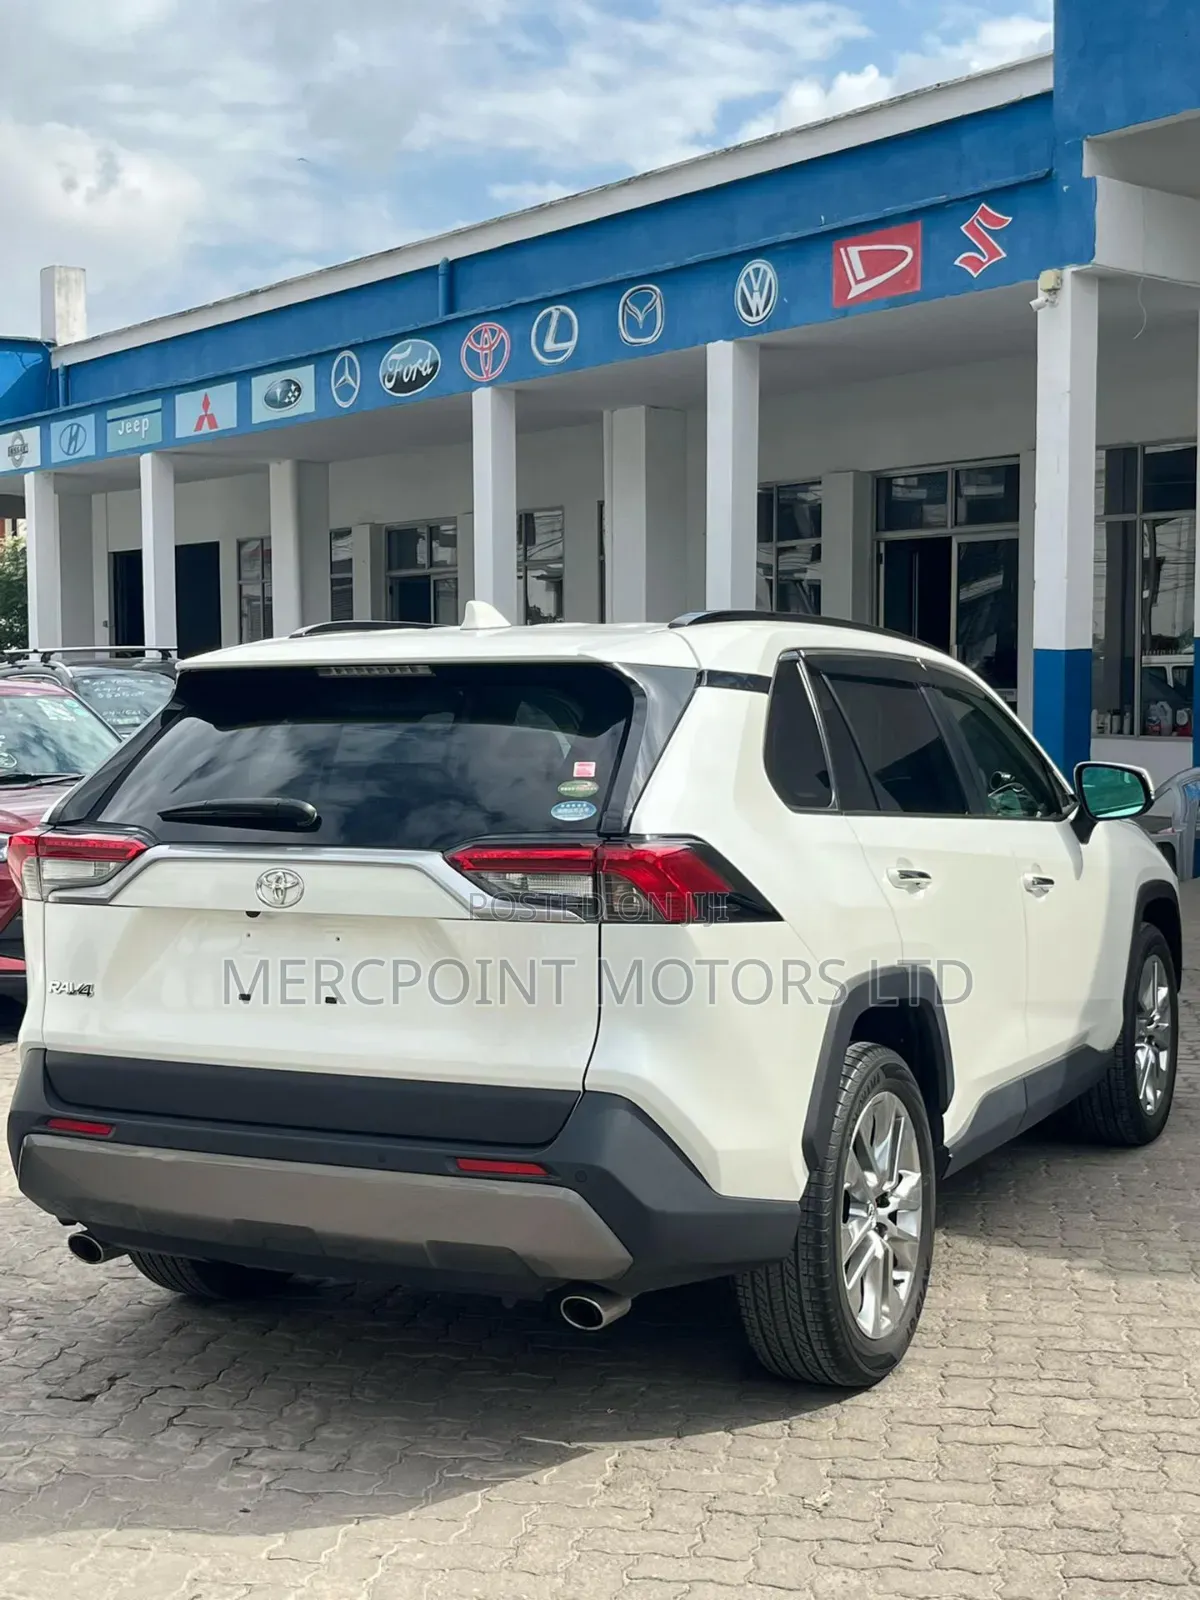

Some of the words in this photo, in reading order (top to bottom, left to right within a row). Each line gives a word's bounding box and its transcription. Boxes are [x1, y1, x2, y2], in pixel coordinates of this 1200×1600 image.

[384, 343, 434, 389] Ford
[117, 414, 150, 439] Jeep
[49, 980, 95, 998] RAV4
